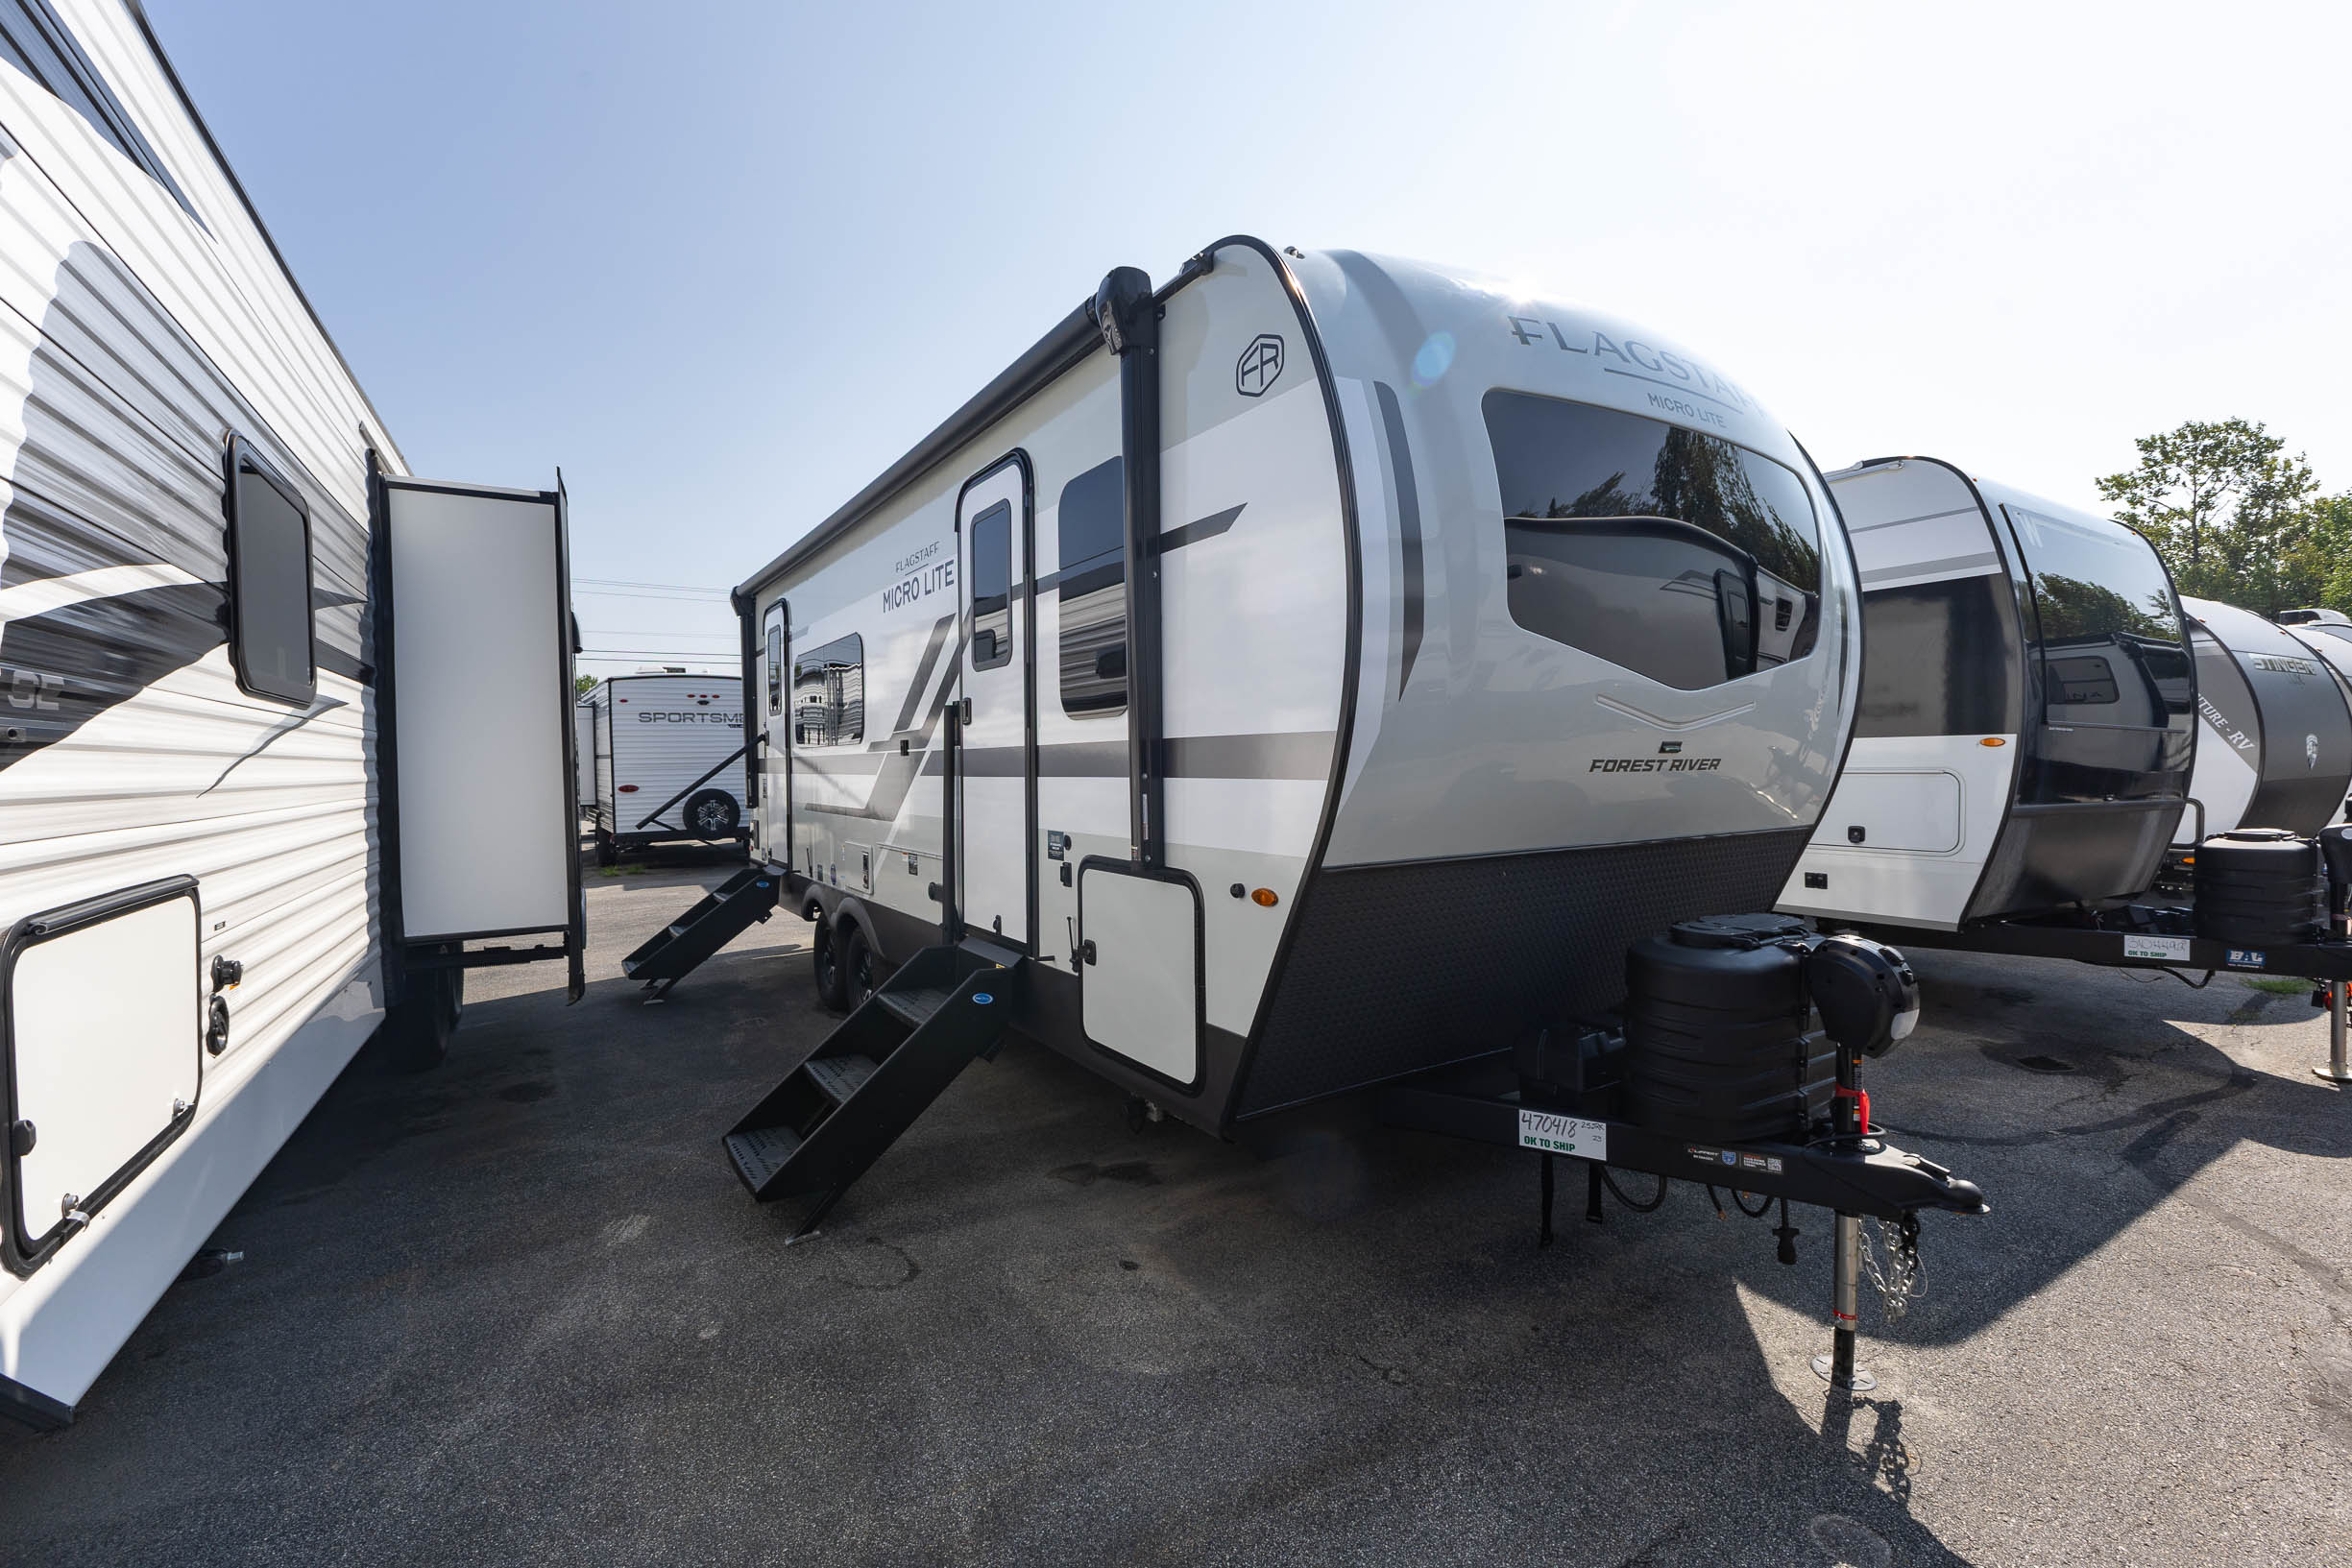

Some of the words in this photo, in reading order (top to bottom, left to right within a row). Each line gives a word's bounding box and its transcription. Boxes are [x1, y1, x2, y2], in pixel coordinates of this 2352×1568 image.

[1647, 392, 1694, 418] MICRO
[1698, 410, 1727, 429] LITE
[895, 541, 939, 573] FLAGSTAFF
[883, 576, 920, 614] MICRO
[924, 559, 955, 595] LITE
[2228, 730, 2256, 749] RV
[1589, 759, 1668, 772] FOREST
[1669, 758, 1721, 771] RIVER
[1521, 1112, 1578, 1139] 470418
[1523, 1135, 1538, 1146] OK
[1539, 1138, 1551, 1148] TO
[1553, 1140, 1576, 1152] SHIP
